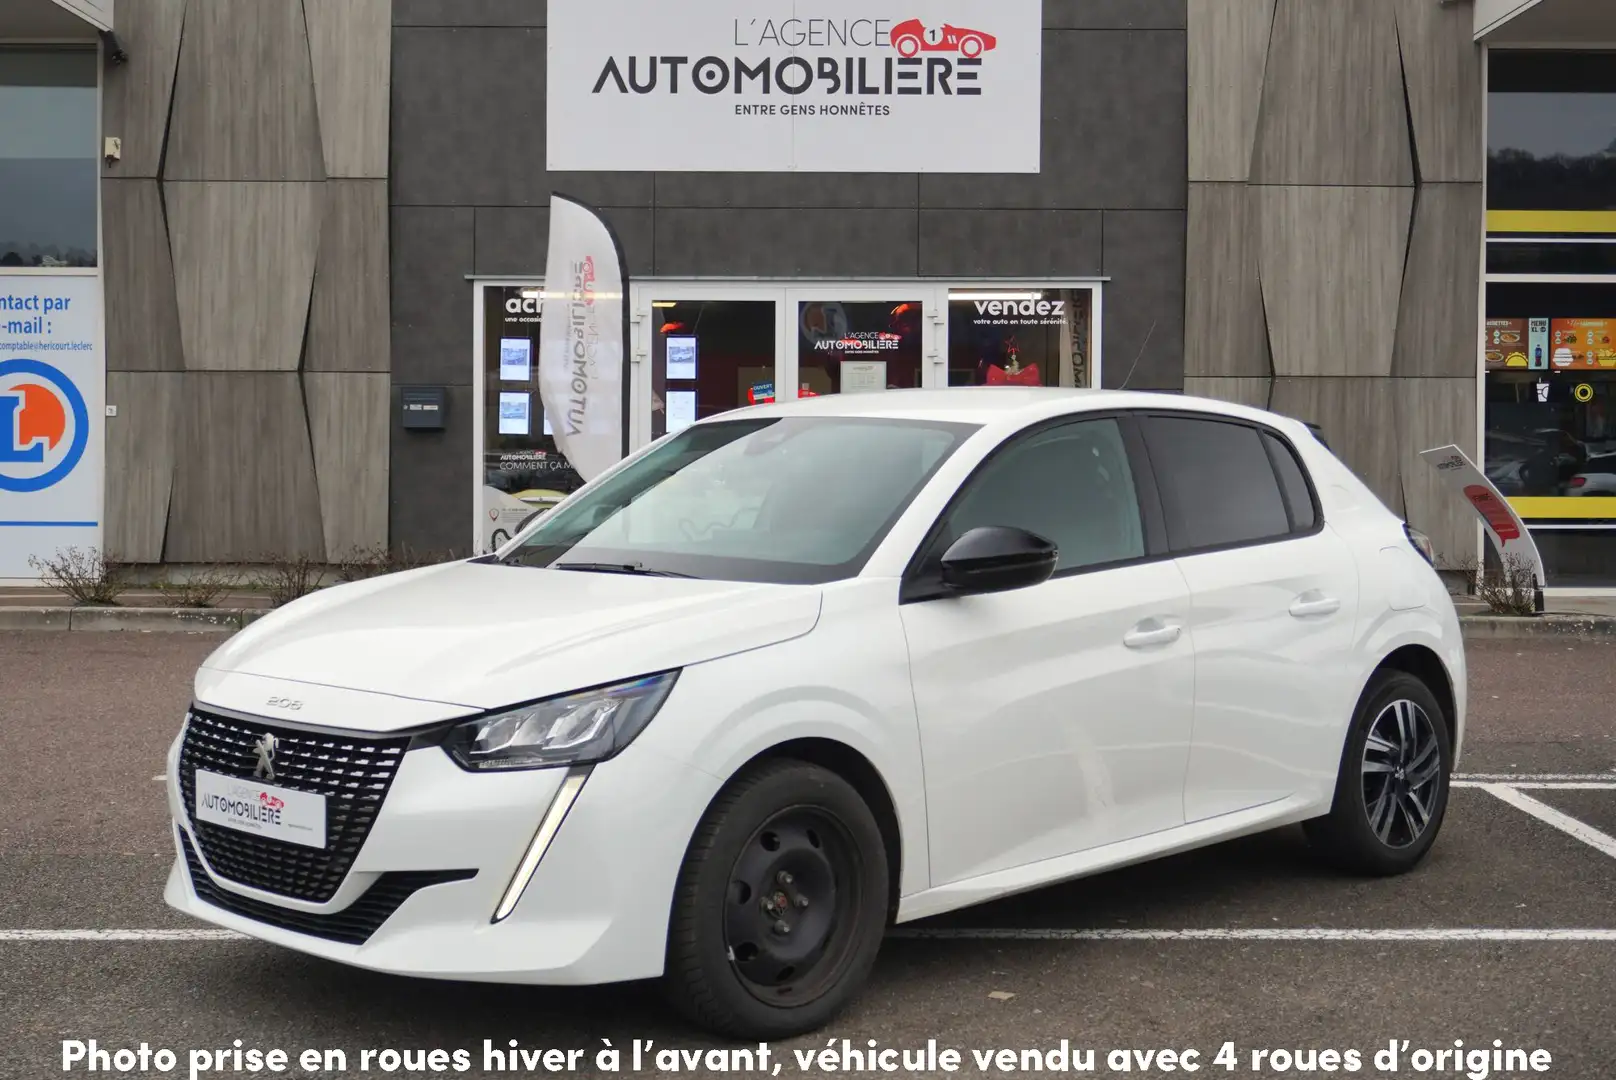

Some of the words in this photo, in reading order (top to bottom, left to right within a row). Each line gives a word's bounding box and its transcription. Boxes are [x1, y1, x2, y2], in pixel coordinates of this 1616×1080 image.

[734, 18, 890, 47] L'AGENCE
[734, 104, 776, 116] ENTRE
[779, 104, 816, 116] GENS
[819, 101, 890, 116] HONNÊTES
[43, 297, 71, 315] par
[974, 292, 1065, 316] vendez
[0, 316, 42, 334] -mail
[519, 315, 544, 323] occasio
[1040, 317, 1069, 325] sérénité.
[844, 331, 879, 340] L'AGENCE
[500, 461, 548, 470] COMMENT
[549, 461, 563, 471] ÇA
